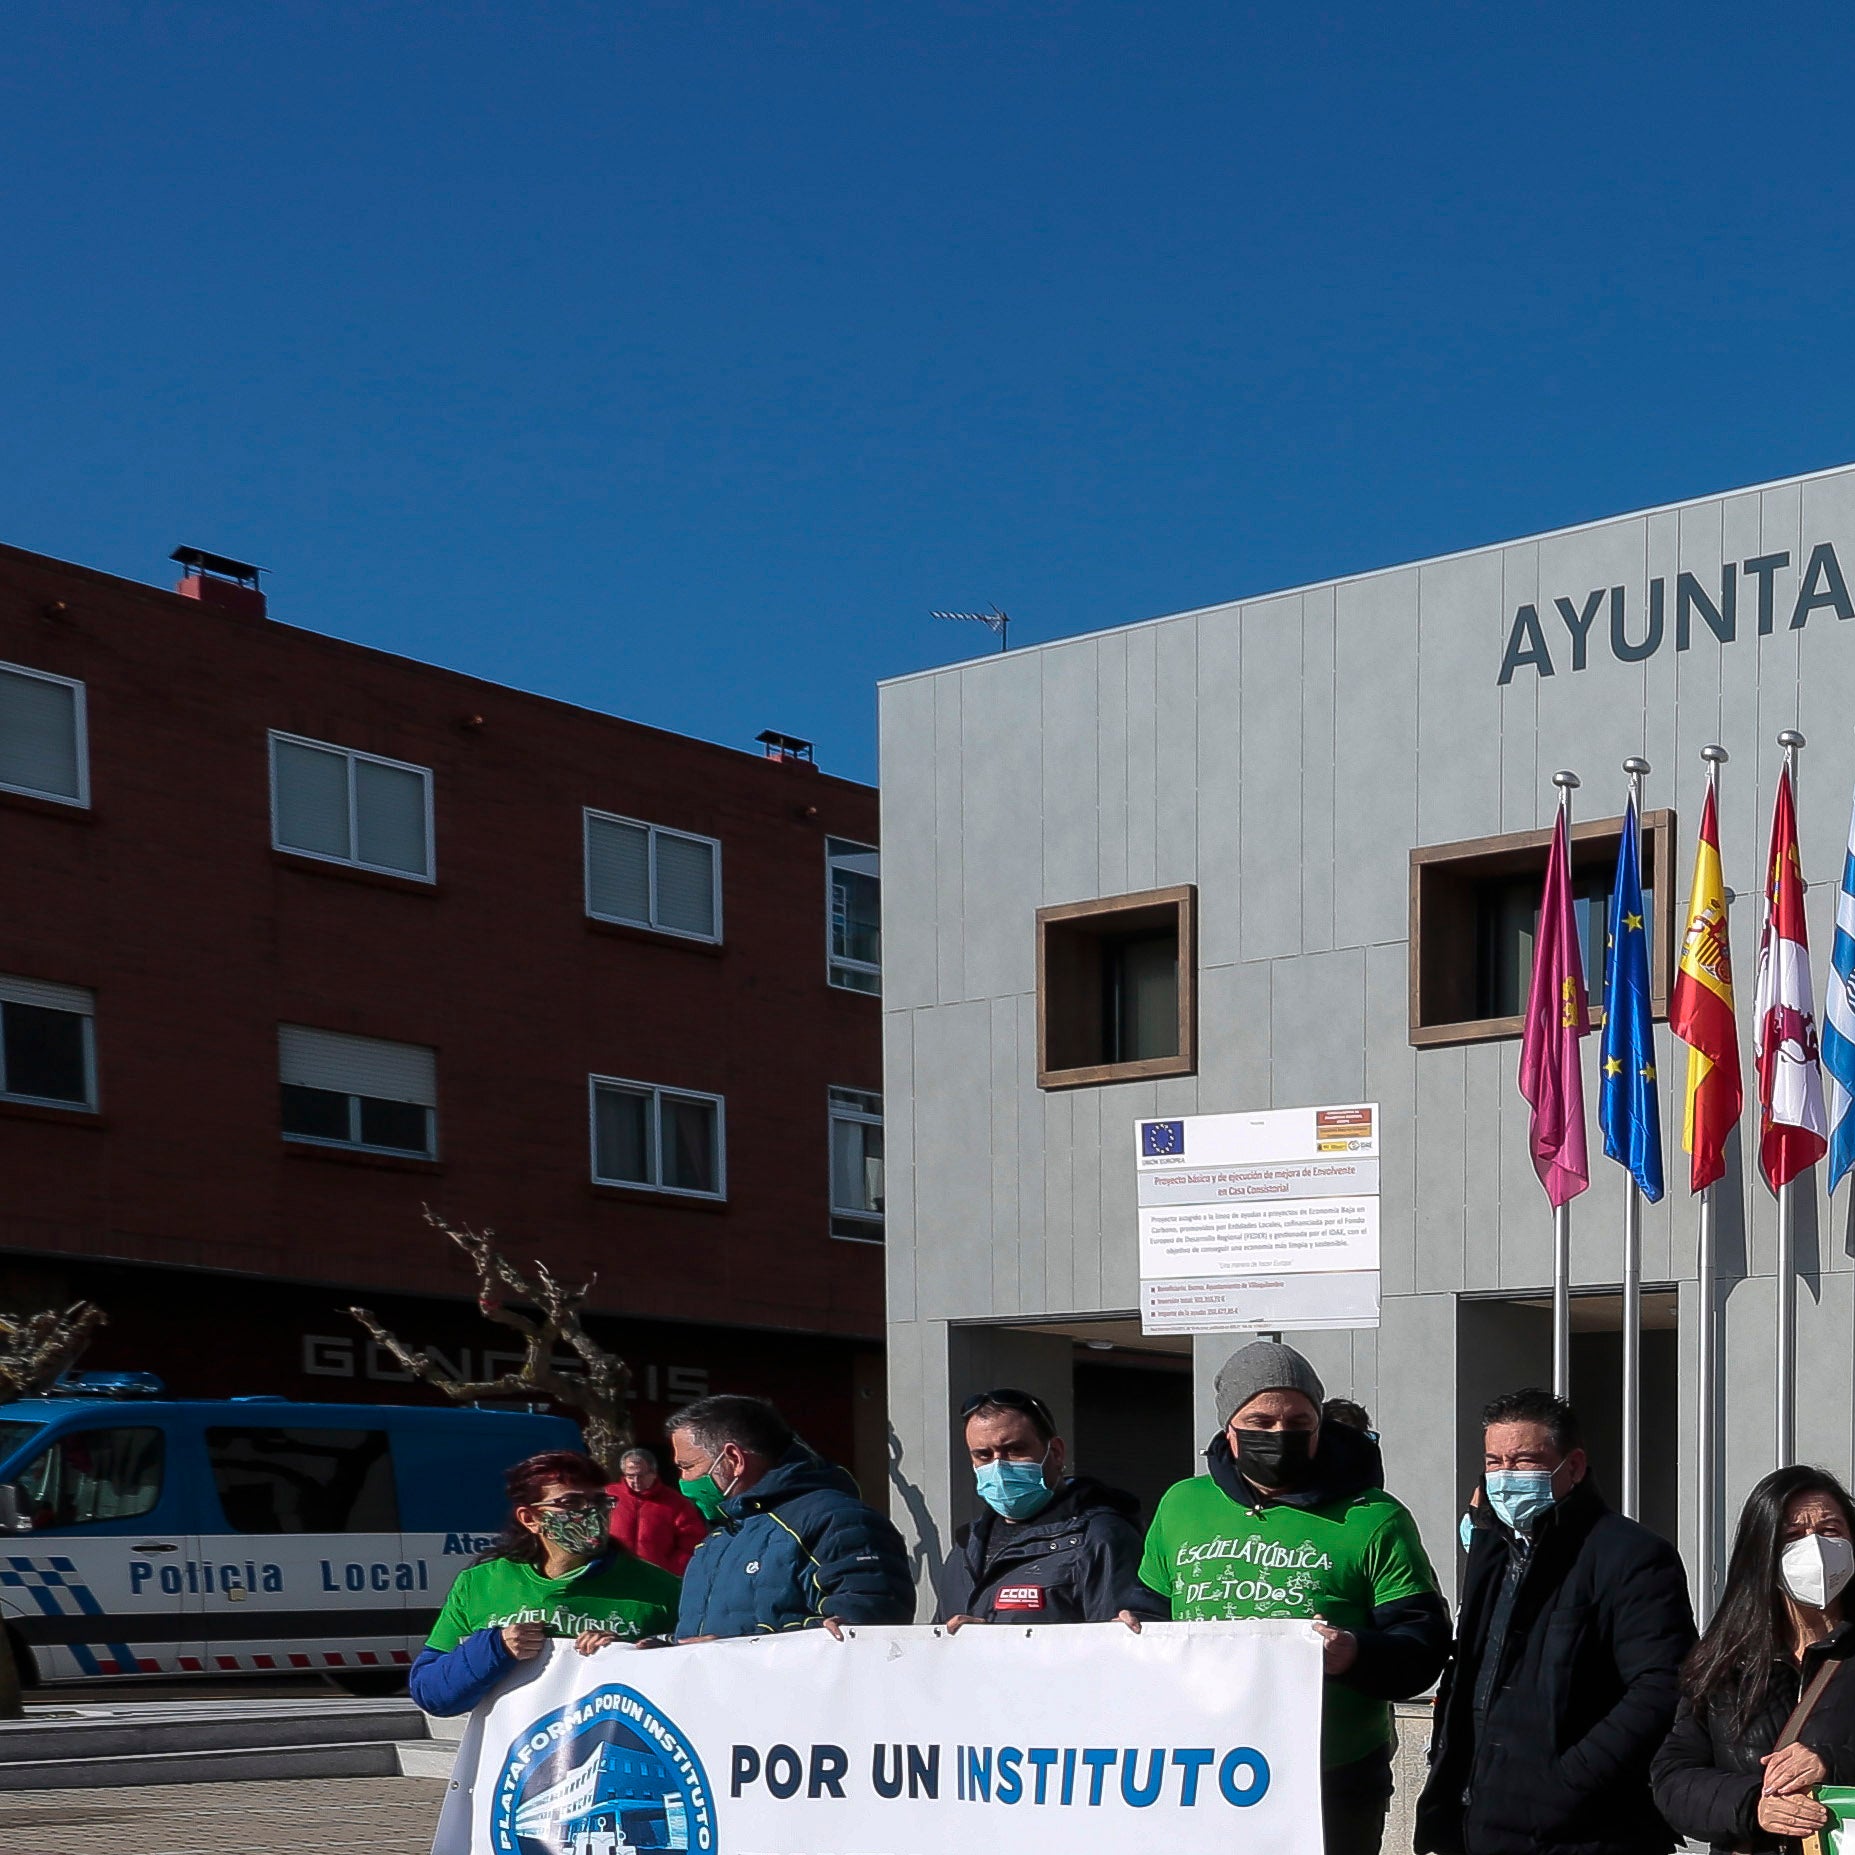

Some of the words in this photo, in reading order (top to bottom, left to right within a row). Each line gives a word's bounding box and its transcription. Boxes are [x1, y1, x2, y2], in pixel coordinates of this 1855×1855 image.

[1176, 1537, 1252, 1566] ESCUELA
[321, 1559, 429, 1592] Local
[1000, 1588, 1039, 1599] CCOO
[1186, 1581, 1212, 1605] DE
[1221, 1579, 1306, 1606] TOD@S
[499, 1704, 595, 1850] PLATAFORMA
[595, 1693, 621, 1714] POR
[621, 1697, 644, 1721] UN
[642, 1713, 711, 1850] INSTITUTO
[730, 1744, 849, 1800] POR
[872, 1743, 940, 1800] UN
[956, 1745, 1271, 1808] INSTITUTO
